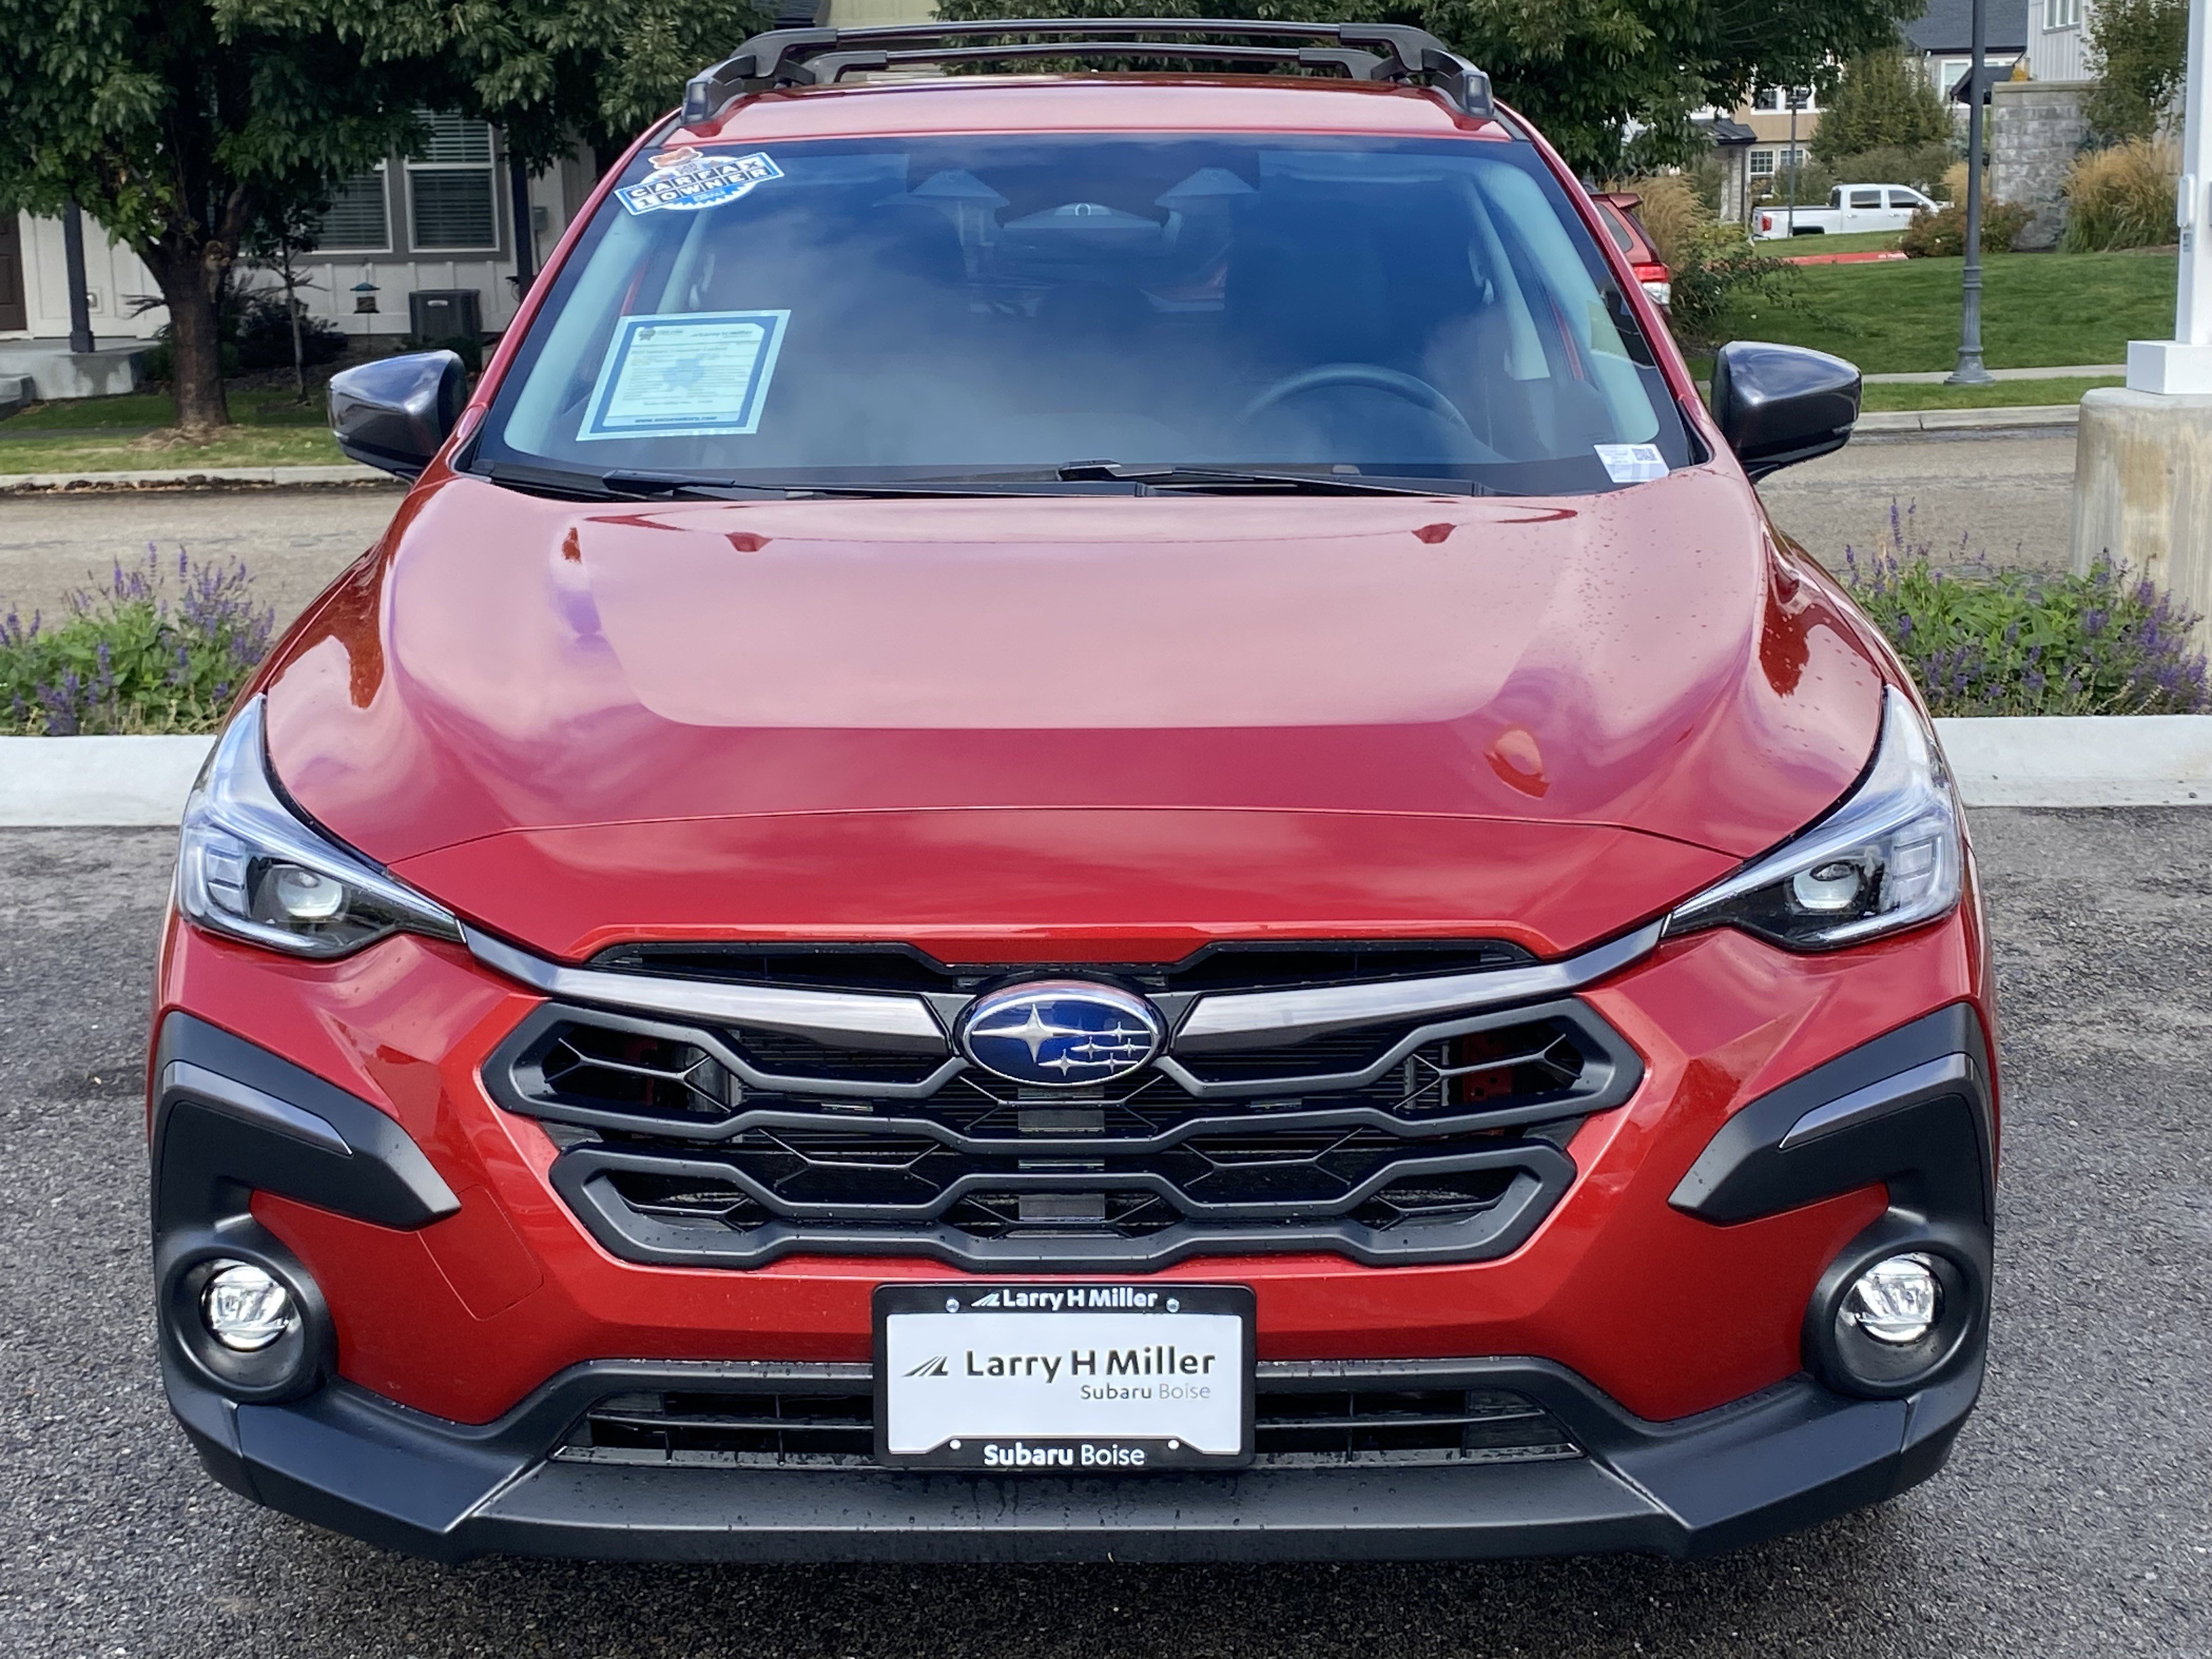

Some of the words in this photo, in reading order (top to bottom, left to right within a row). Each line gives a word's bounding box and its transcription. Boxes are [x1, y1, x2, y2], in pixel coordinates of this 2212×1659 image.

[630, 159, 759, 198] CARFAX
[638, 198, 653, 207] 1
[660, 168, 769, 202] OWNER
[1002, 1289, 1064, 1311] Larry
[1067, 1289, 1085, 1307] H
[1088, 1286, 1158, 1307] Miller
[966, 1350, 1062, 1384] Larry
[1071, 1349, 1096, 1376] H
[1106, 1345, 1215, 1375] Miller
[1080, 1382, 1152, 1400] Subaru
[1159, 1382, 1211, 1400] Boise
[983, 1441, 1073, 1466] Subaru
[1080, 1443, 1145, 1466] Boise
